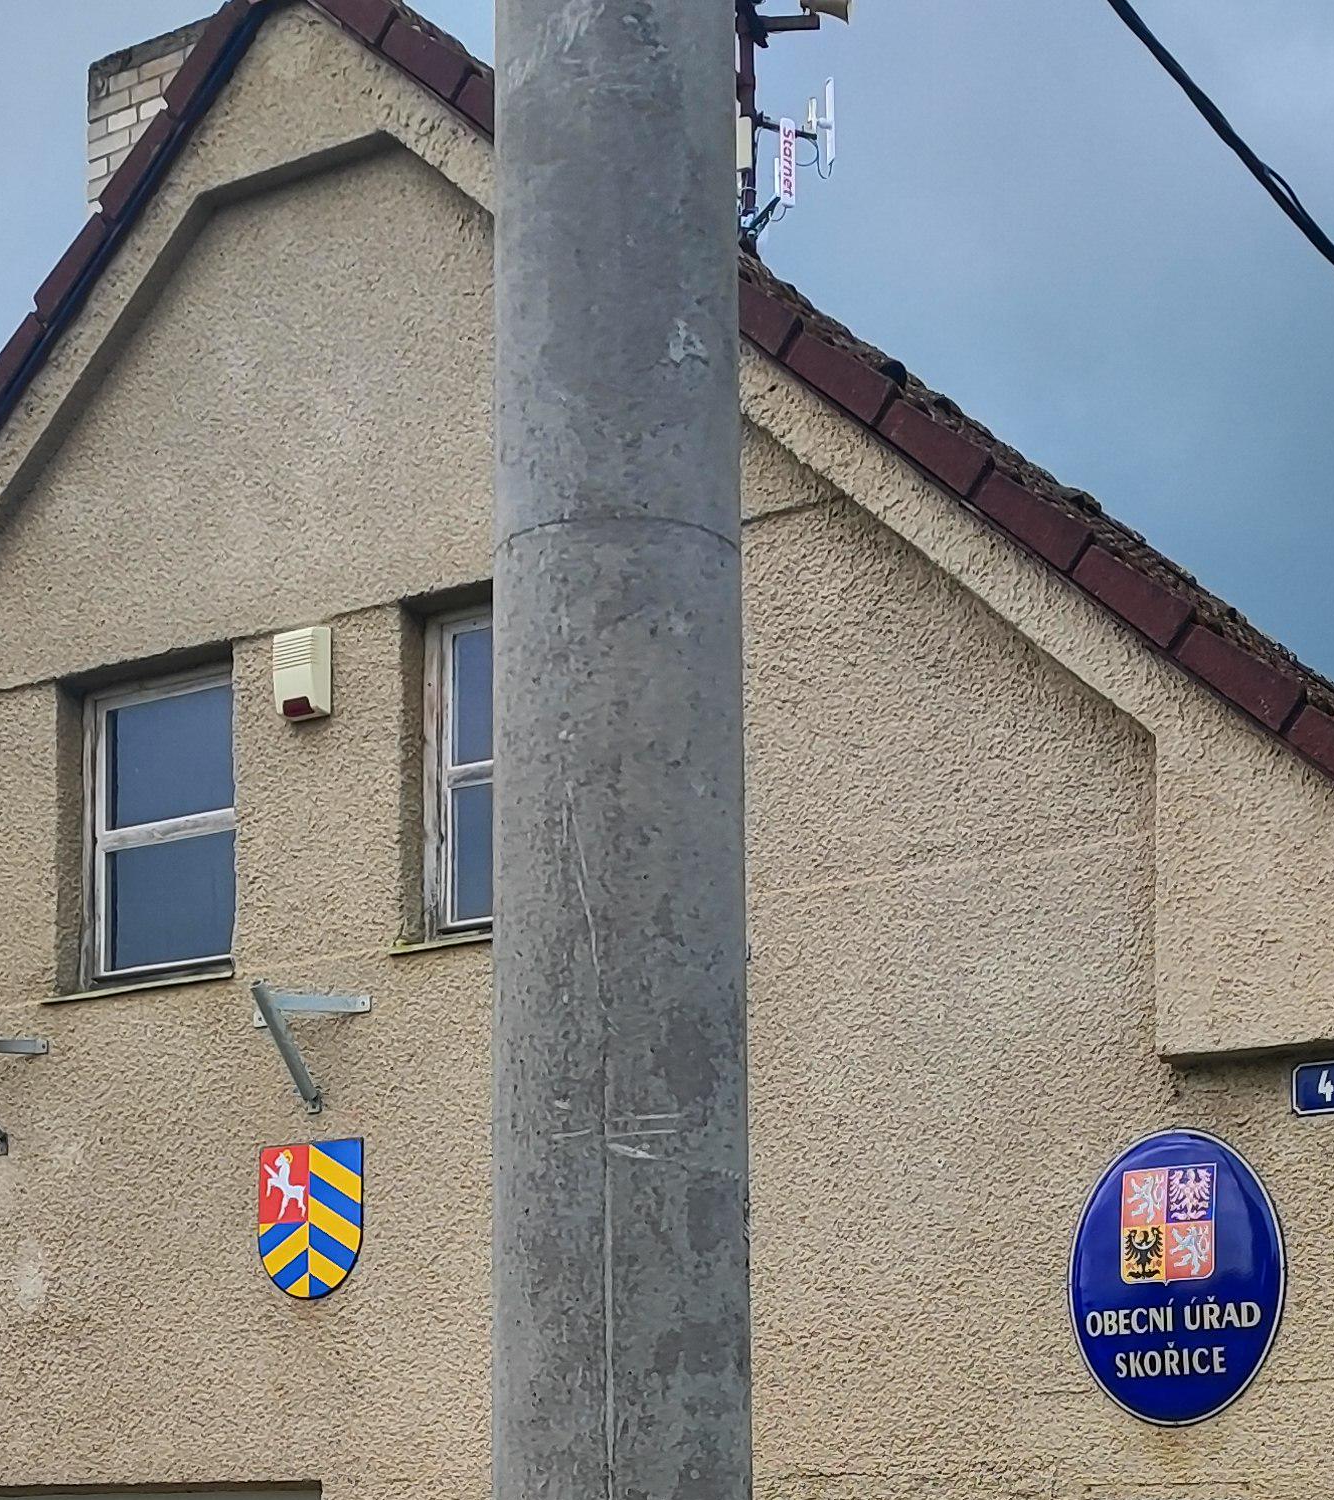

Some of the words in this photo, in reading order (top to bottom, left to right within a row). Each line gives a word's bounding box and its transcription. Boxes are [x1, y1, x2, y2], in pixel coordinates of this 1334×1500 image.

[783, 127, 794, 197] Starnet
[1317, 1070, 1334, 1101] 4
[1086, 1298, 1173, 1337] OBECNÍ
[1184, 1296, 1261, 1330] ÚŘAD
[1116, 1342, 1227, 1378] SKOŘICE
